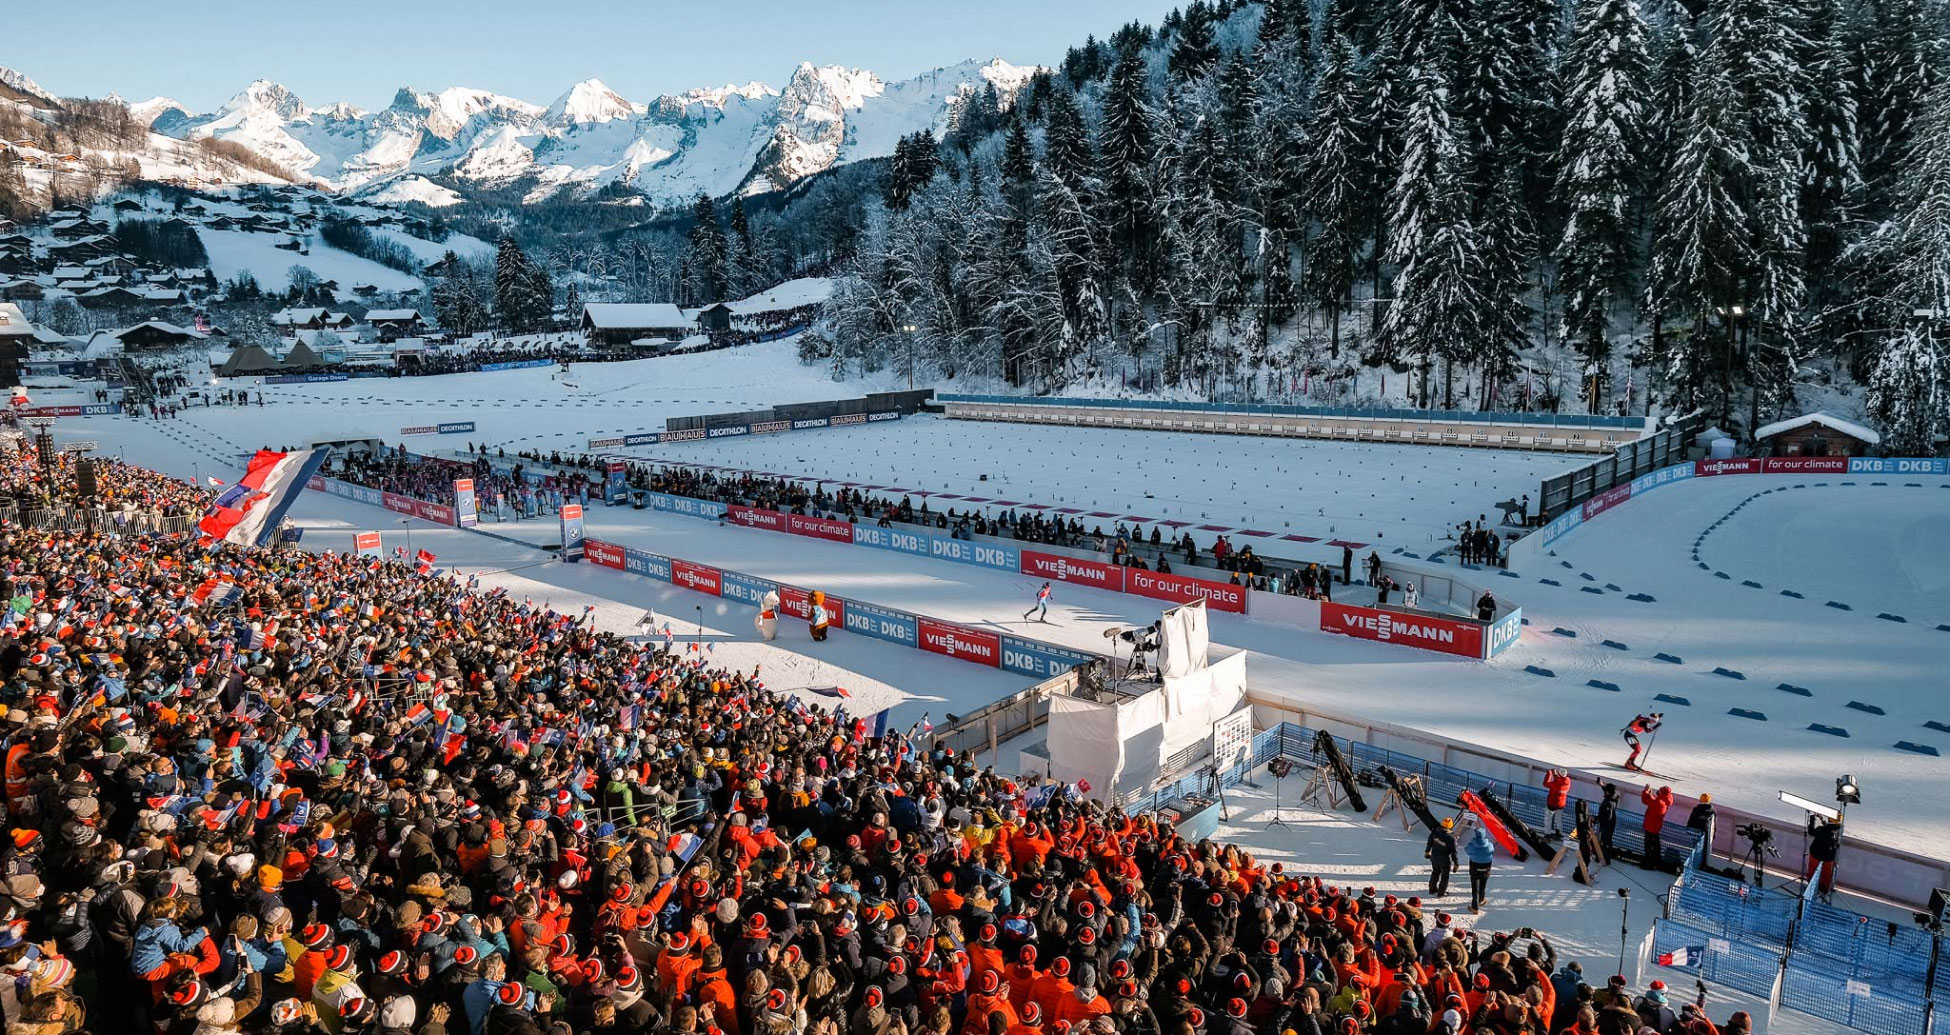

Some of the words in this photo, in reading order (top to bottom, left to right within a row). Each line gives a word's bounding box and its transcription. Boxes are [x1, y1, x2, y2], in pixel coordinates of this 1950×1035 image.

[86, 406, 108, 414] DKB
[868, 411, 899, 421] DECATHLON
[794, 418, 828, 428] DECATHLON
[830, 414, 867, 425] BAUHAUS
[709, 426, 747, 437] DECATHLON
[750, 422, 792, 434] BAUHAUS
[627, 436, 657, 444] DECATHLON
[659, 430, 706, 442] BAUHAUS
[1703, 461, 1749, 474] VIESSMANN
[1768, 459, 1783, 469] for
[1784, 461, 1802, 469] our
[1803, 459, 1844, 469] climate
[1852, 460, 1883, 471] DKB
[1899, 460, 1932, 472] DKB
[1672, 466, 1687, 479] DKB
[387, 497, 411, 511] VIESSMANN
[650, 494, 666, 508] DKB
[674, 500, 692, 513] DKB
[421, 505, 448, 520] VIESSMANN
[700, 503, 718, 517] DKB
[735, 510, 777, 526] VIESSMANN
[791, 517, 802, 529] for
[804, 521, 818, 531] our
[819, 523, 850, 537] climate
[855, 527, 880, 545] DKB
[891, 533, 918, 551] DKB
[588, 548, 621, 564] VIESSMANN
[933, 539, 961, 558] DKB
[627, 557, 642, 570] DKB
[975, 546, 1005, 567] DKB
[648, 562, 664, 577] DKB
[1035, 559, 1106, 581] VIESSMANN
[676, 570, 716, 589] VIESSMANN
[724, 582, 742, 597] DKB
[750, 589, 765, 603] DK
[1134, 573, 1154, 588] for
[1157, 579, 1182, 593] our
[1184, 582, 1239, 604] climate
[847, 612, 870, 630] DKB
[1342, 613, 1454, 643] VIESSMANN
[881, 621, 905, 639] DKB
[1494, 622, 1513, 650] DKB
[926, 633, 991, 657] VIESSMANN
[1004, 650, 1034, 670] DKB
[1049, 661, 1071, 676] DK
